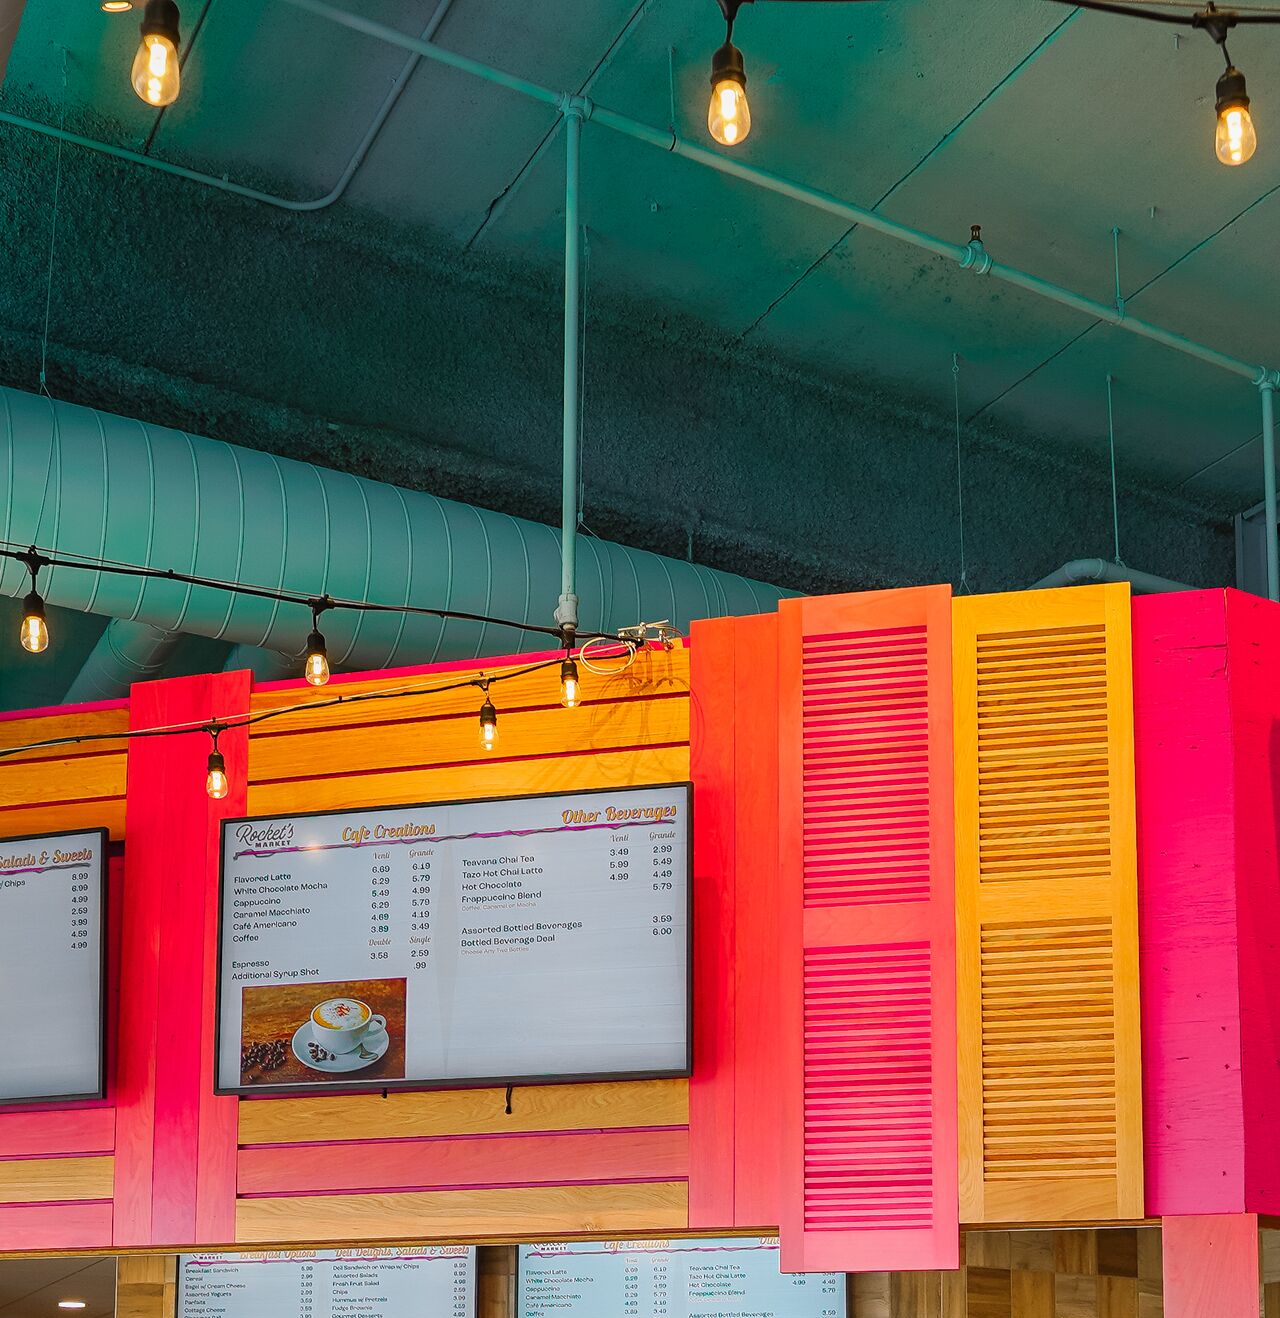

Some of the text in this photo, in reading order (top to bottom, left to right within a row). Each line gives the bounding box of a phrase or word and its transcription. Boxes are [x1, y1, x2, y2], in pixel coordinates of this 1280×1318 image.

[561, 805, 677, 825] Other Beverages
[236, 823, 294, 847] Rocket's
[374, 822, 436, 839] Creations
[649, 831, 676, 841] Grande
[255, 840, 292, 848] MARKET
[409, 848, 435, 858] Grande
[610, 848, 629, 857] 3.49
[653, 845, 672, 853] 2.99
[39, 851, 50, 865] &
[52, 848, 92, 864] Sweets
[499, 856, 518, 864] Chai
[653, 857, 672, 866] 5.49
[500, 868, 519, 876] Chai
[521, 867, 543, 875] Latte
[653, 870, 672, 878] 4.49
[71, 872, 89, 881] 8.99
[234, 873, 292, 883] Flavored Latte
[372, 877, 390, 885] 6.29
[412, 874, 431, 882] 5.79
[4, 880, 26, 888] Chips
[259, 885, 299, 894] Chocolate
[300, 882, 328, 890] Mocha
[479, 881, 522, 890] Chocolate
[653, 882, 672, 891] 5.79
[372, 889, 390, 897] 5.49
[412, 886, 430, 894] 4.99
[71, 895, 88, 903] 4.99
[462, 890, 542, 904] Frappuccino Blend
[233, 898, 281, 908] Cappuccino
[371, 901, 390, 909] 6.29
[412, 898, 430, 907] 5.79
[233, 908, 311, 919] Caramel Macchiato
[412, 910, 430, 918] 4.19
[71, 918, 88, 927] 3.99
[652, 915, 672, 923] 3.59
[233, 921, 297, 930] Café Americano
[371, 925, 389, 933] 3.89
[462, 922, 583, 935] Assorted Bottled Beverages
[71, 930, 88, 938] 4.59
[652, 927, 672, 936] 6.00
[233, 934, 259, 942] Coffee
[369, 938, 392, 946] Double
[409, 935, 431, 945] Single
[461, 934, 555, 947] Bottled Beverage Deal
[71, 941, 88, 949] 4.99
[232, 960, 270, 969] Espresso
[414, 961, 427, 970] .99
[232, 968, 319, 980] Additional Syrup Shot
